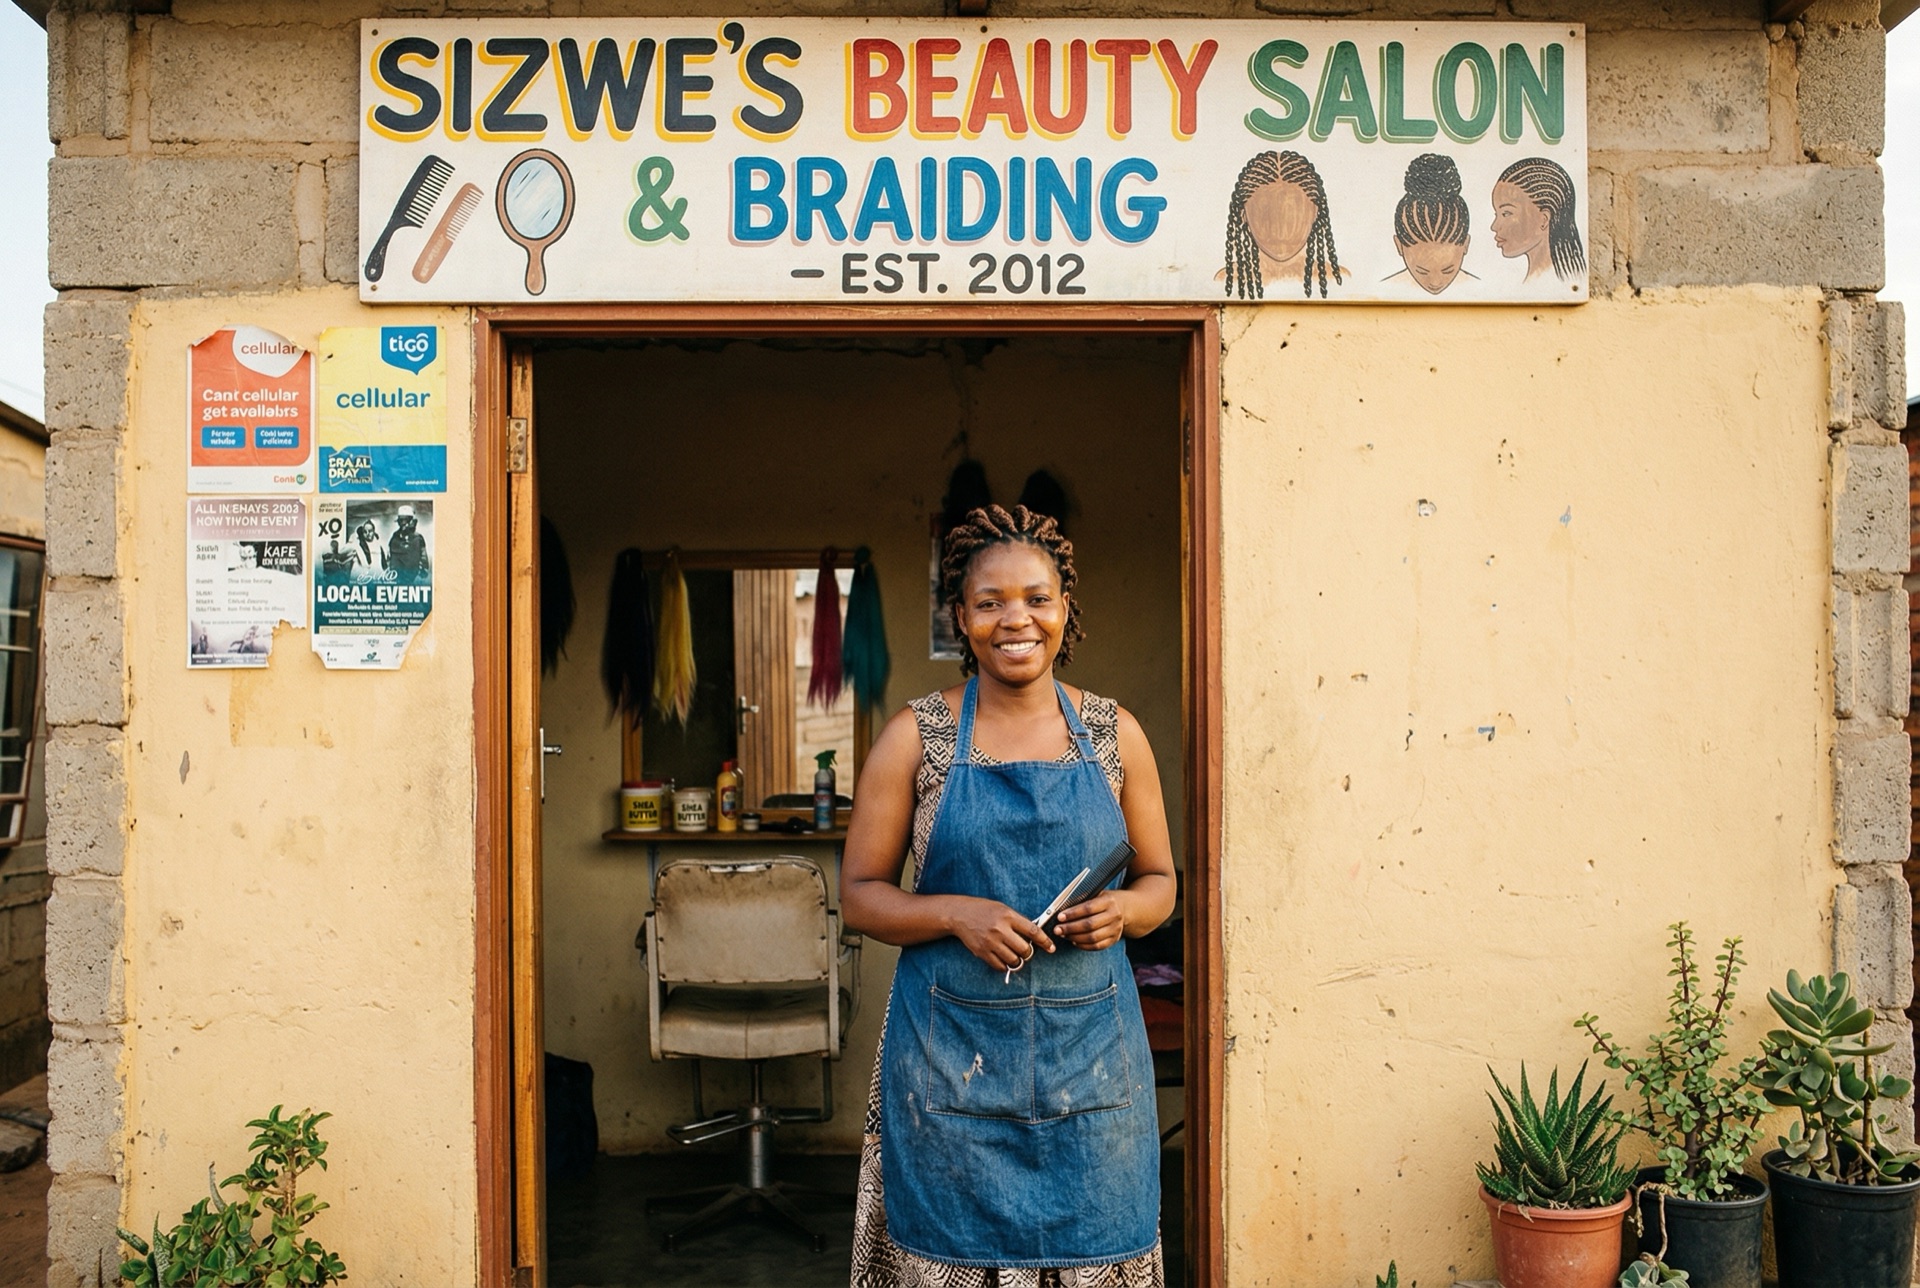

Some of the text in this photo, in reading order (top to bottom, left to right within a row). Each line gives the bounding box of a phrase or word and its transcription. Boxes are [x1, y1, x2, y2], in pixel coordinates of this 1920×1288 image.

[367, 20, 1565, 144] SIZWE'S BEAUTY SALON
[624, 155, 1167, 247] & BRAIDING
[841, 253, 948, 294] EST.
[968, 252, 1087, 295] 2012
[241, 341, 297, 354] cellular
[242, 388, 299, 402] cellular
[336, 387, 431, 409] cellular
[202, 404, 229, 421] get
[195, 503, 216, 514] ALL
[261, 516, 298, 526] EVENT
[263, 545, 297, 557] KAFE
[317, 585, 431, 603] LOCAL EVENT
